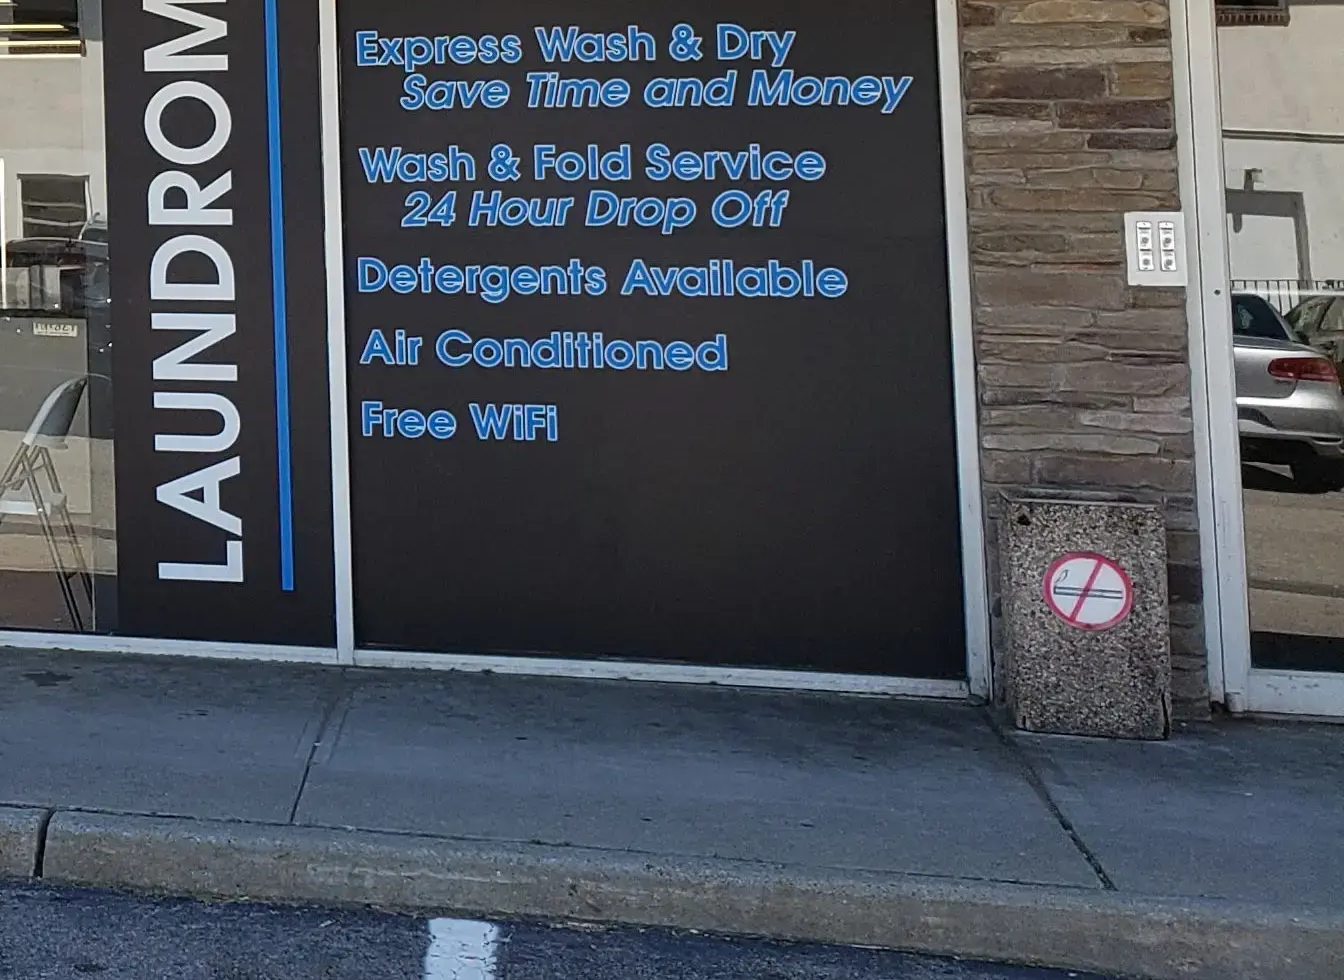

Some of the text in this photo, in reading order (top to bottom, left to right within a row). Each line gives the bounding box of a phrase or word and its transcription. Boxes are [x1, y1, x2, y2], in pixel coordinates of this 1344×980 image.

[355, 23, 797, 72] Express Wash & Dry
[400, 69, 914, 113] Save Time and Money
[359, 143, 827, 183] Wash & Fold Service
[401, 189, 791, 235] 24 Hour Drop Off
[357, 256, 849, 304] Detergents Available
[360, 328, 729, 372] Air Conditioned
[361, 401, 559, 442] Free WiFi
